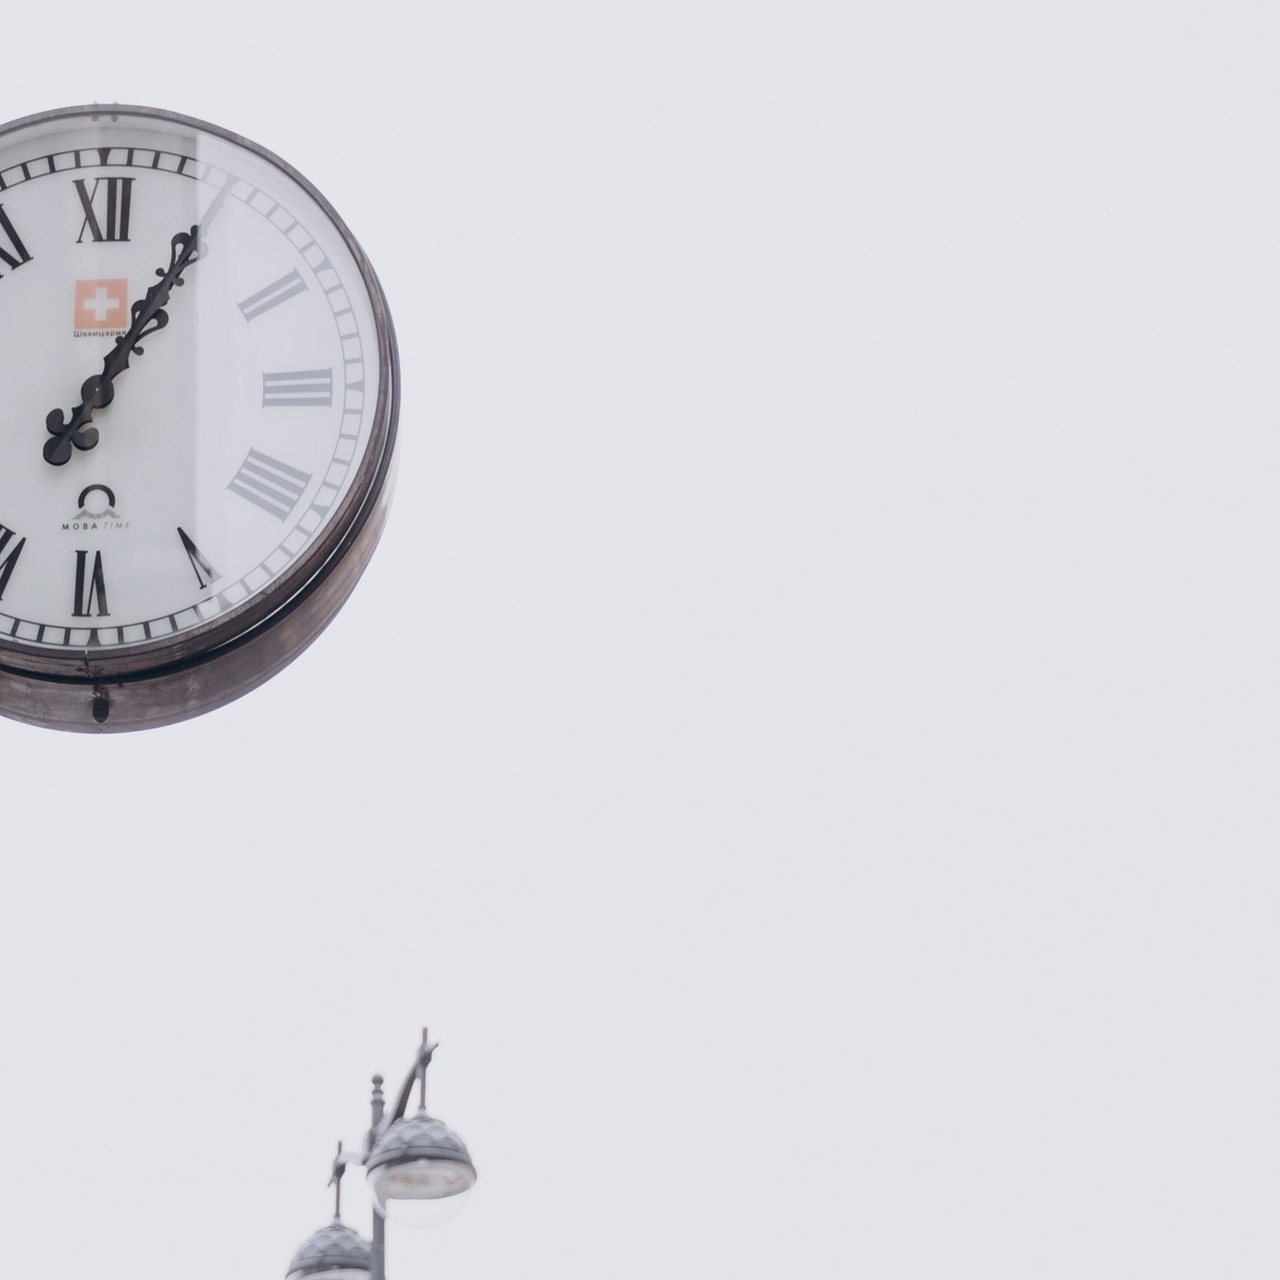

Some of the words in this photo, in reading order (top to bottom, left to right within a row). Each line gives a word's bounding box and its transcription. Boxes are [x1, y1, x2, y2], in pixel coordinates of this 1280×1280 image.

[72, 177, 136, 243] XII
[236, 267, 309, 323] II
[262, 367, 332, 408] III
[225, 446, 313, 523] IIII
[71, 550, 110, 617] VI
[177, 526, 223, 590] V
